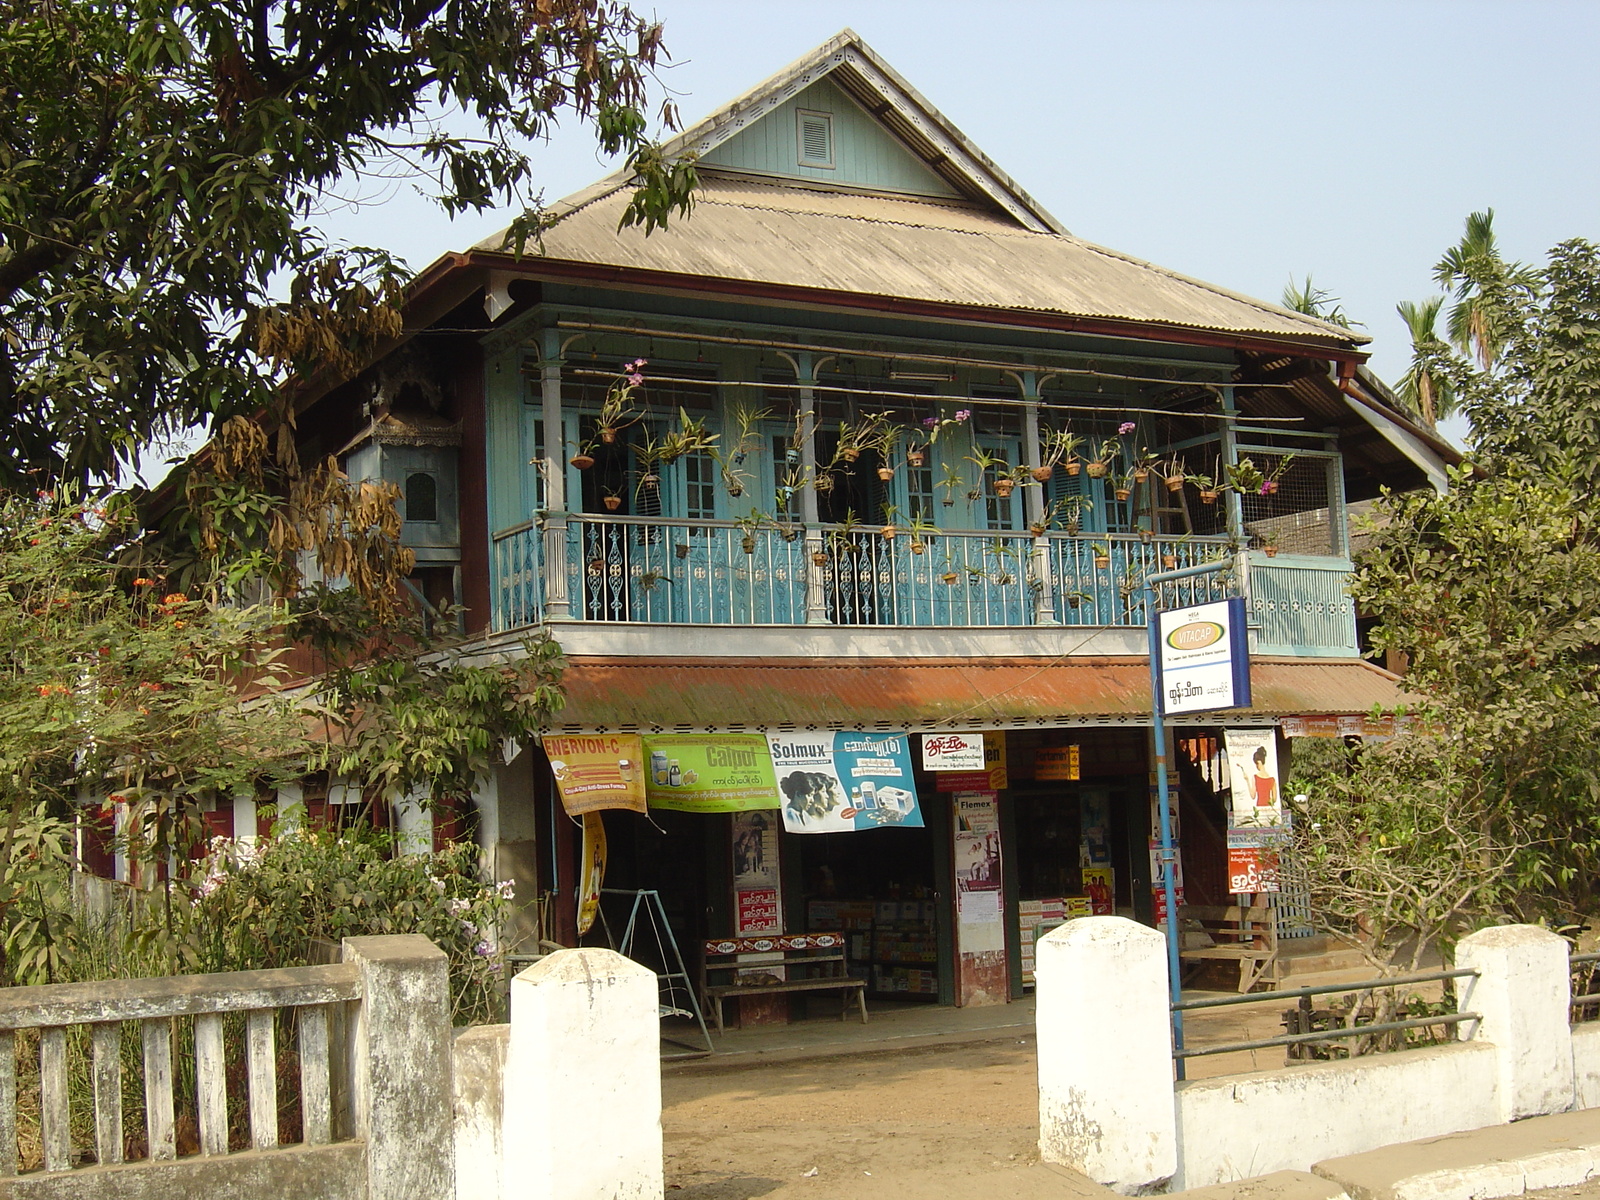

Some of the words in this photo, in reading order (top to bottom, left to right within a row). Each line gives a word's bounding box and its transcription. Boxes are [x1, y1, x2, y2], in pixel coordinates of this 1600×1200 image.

[1178, 627, 1212, 644] VITACAP
[543, 738, 620, 756] ENERVON-C
[772, 743, 826, 758] Solmux
[705, 745, 758, 770] Calpol
[961, 801, 991, 809] Flemex
